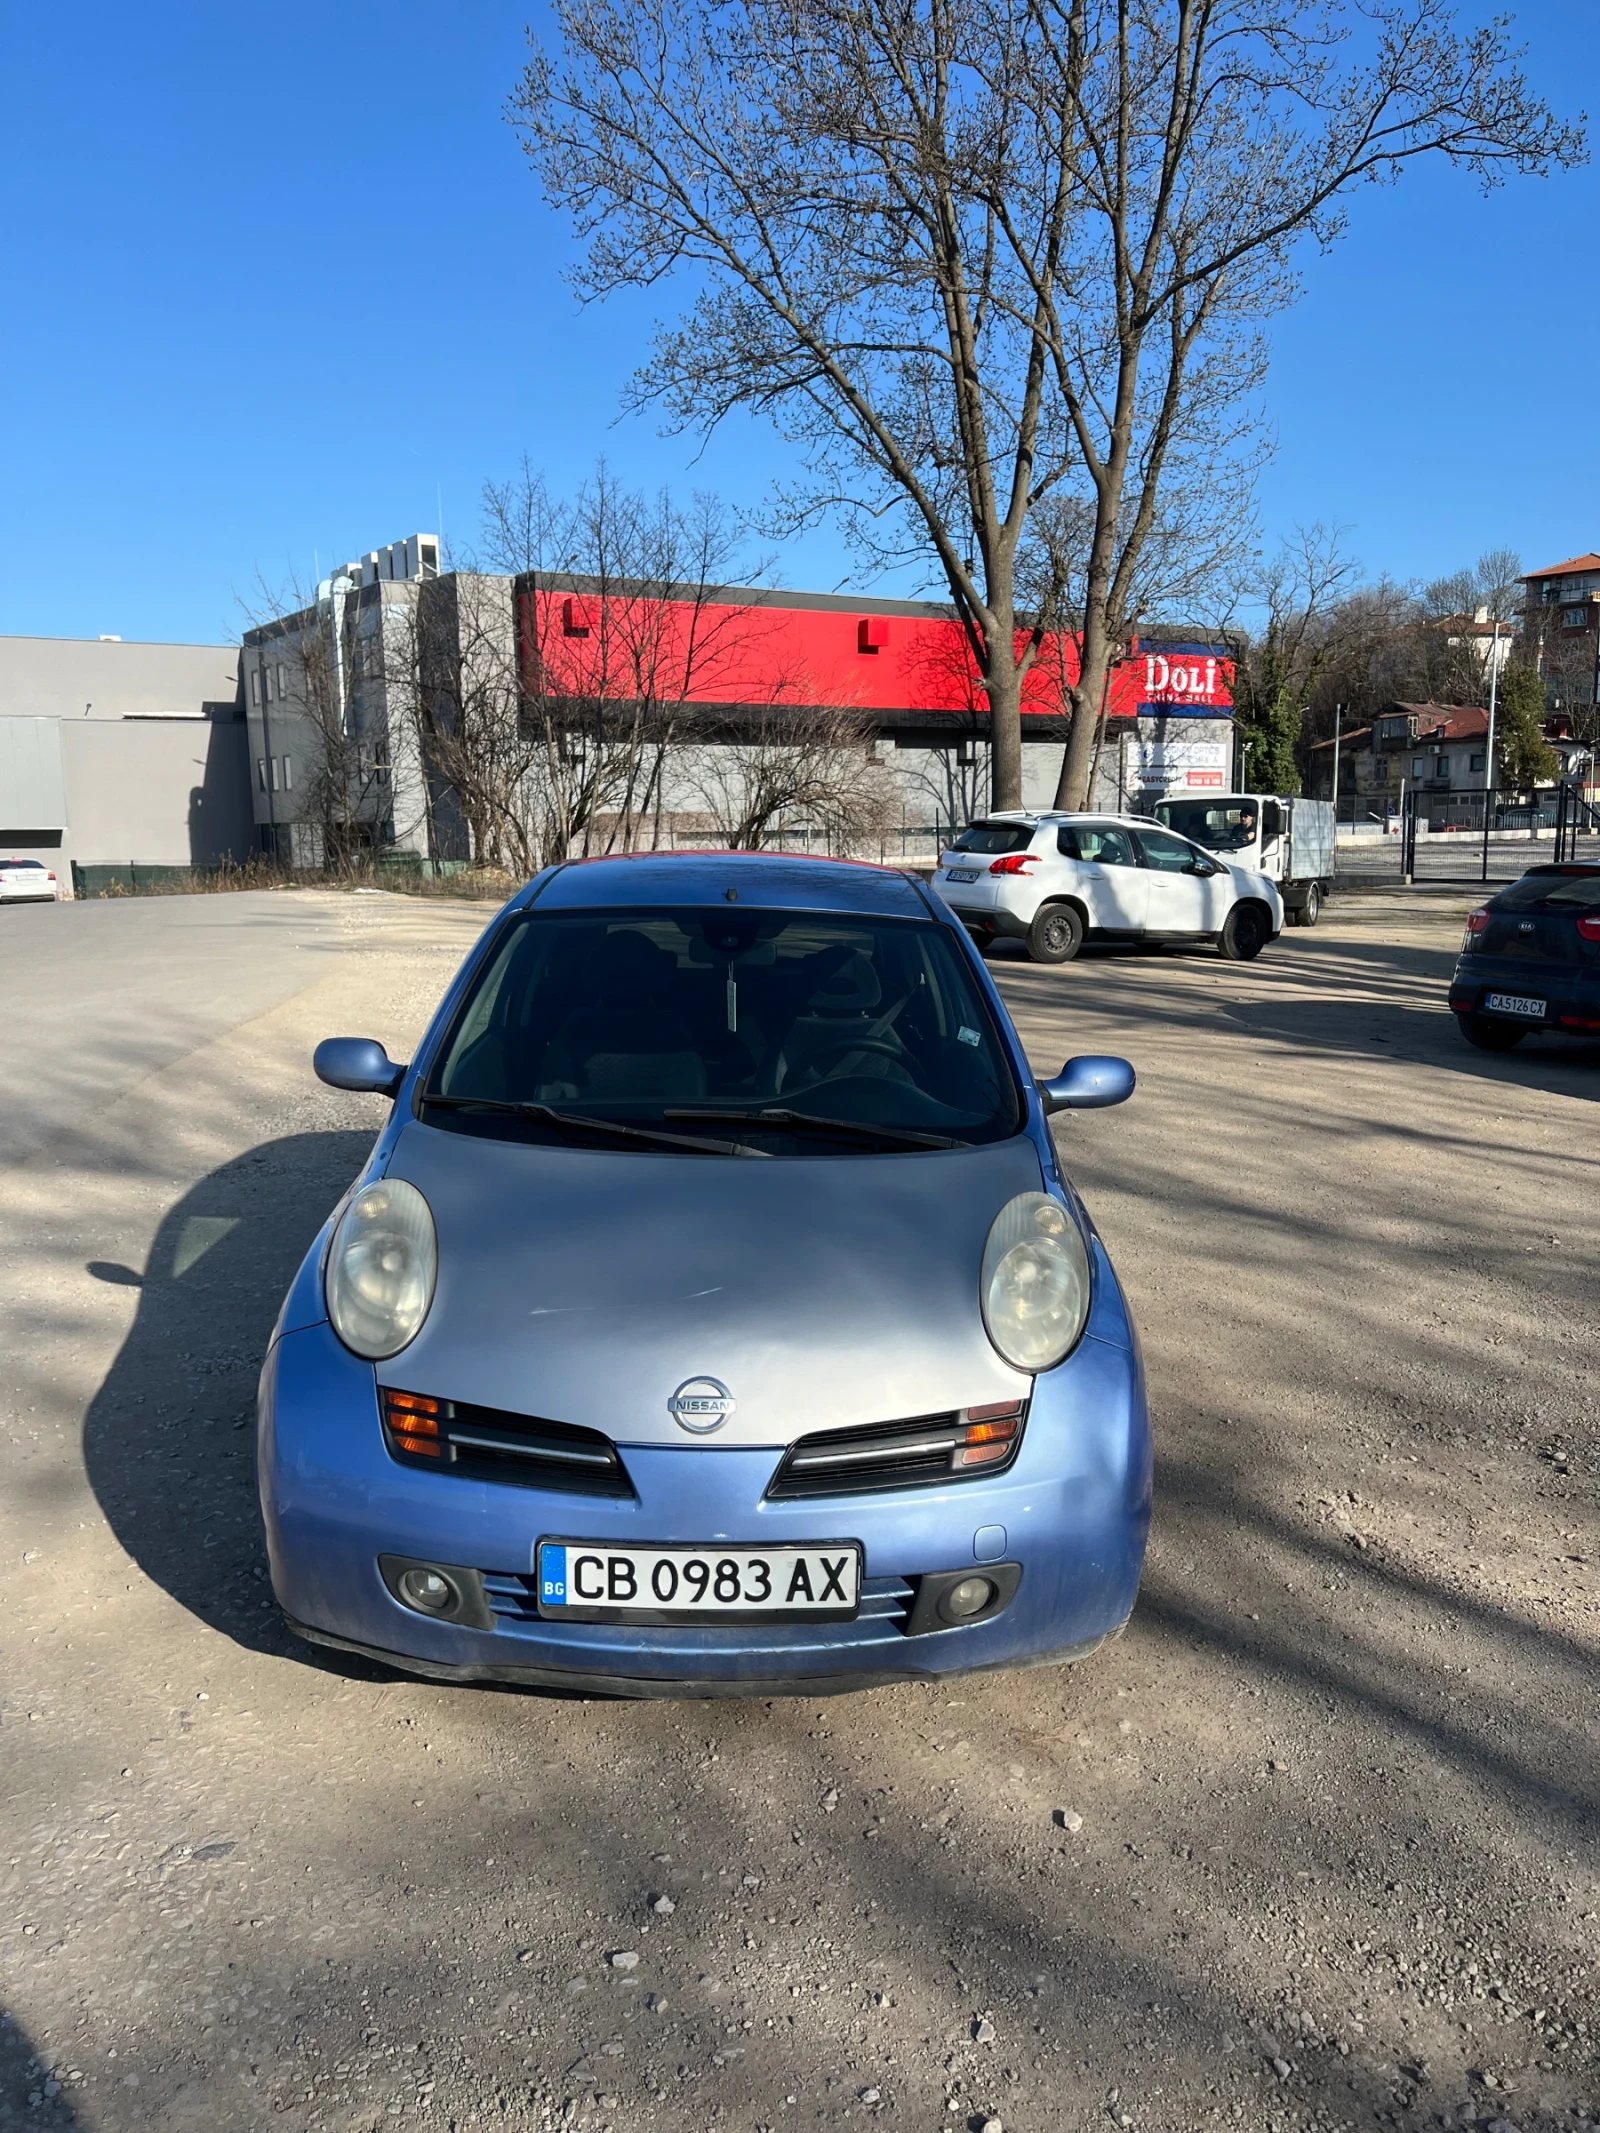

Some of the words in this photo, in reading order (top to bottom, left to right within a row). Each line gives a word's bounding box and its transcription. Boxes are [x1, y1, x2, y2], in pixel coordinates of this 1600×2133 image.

[676, 1400, 730, 1411] NISSAN
[574, 1556, 638, 1600] CB
[651, 1559, 771, 1602] 0983
[785, 1557, 849, 1602] AX
[544, 1581, 564, 1595] BG
